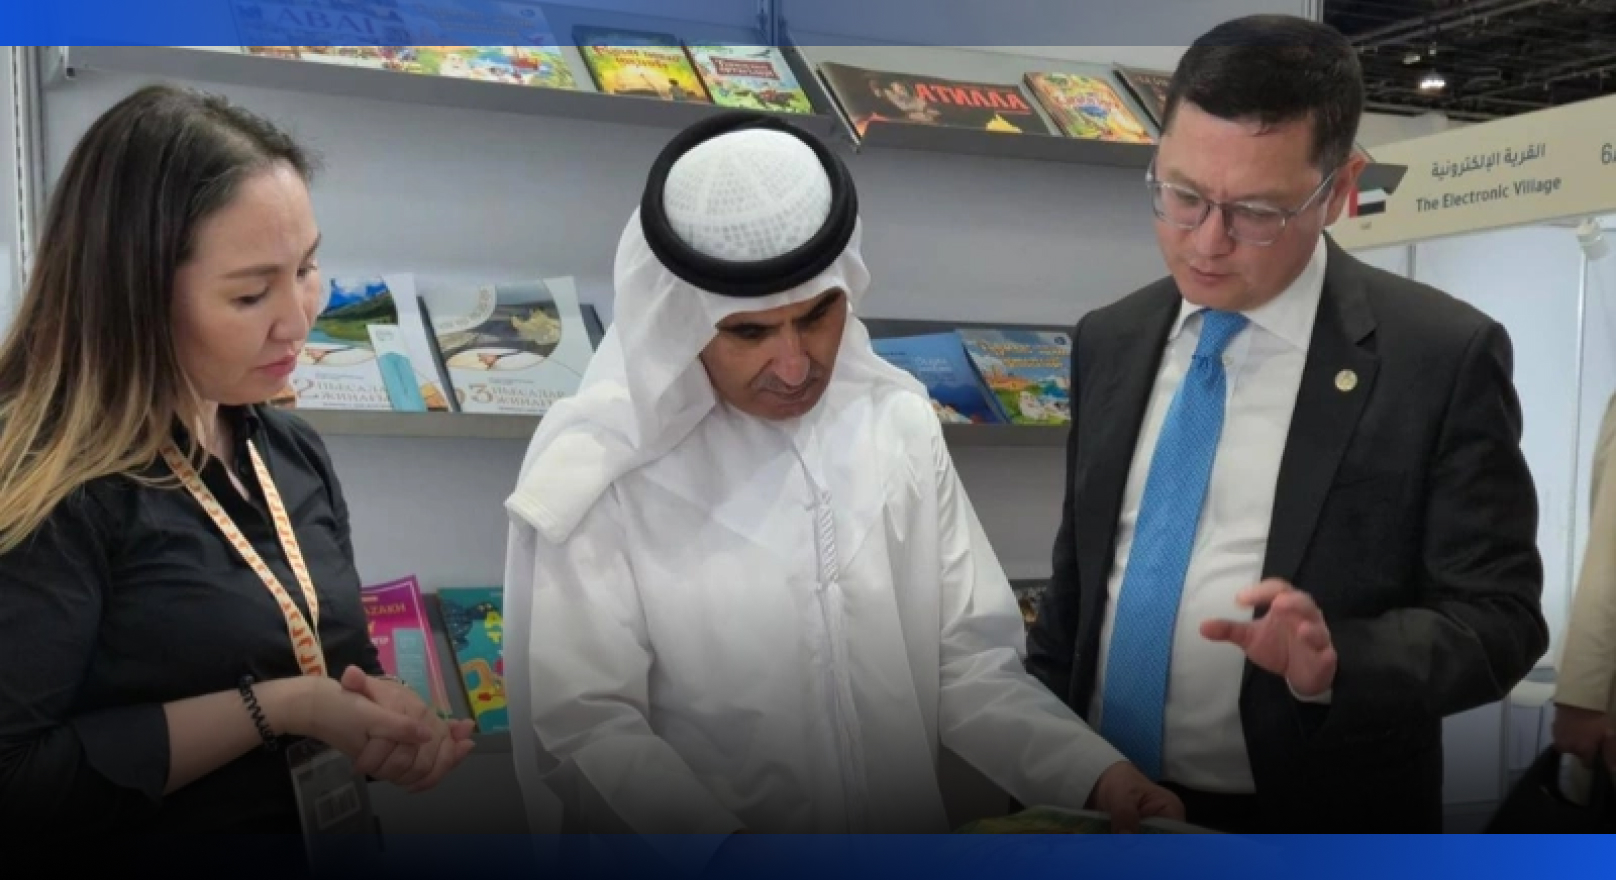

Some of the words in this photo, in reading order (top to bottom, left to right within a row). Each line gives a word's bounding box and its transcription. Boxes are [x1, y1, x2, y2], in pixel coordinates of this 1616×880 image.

[915, 84, 1030, 110] АТИЛЛА
[1431, 153, 1501, 179] الإلكترونية
[1504, 144, 1545, 167] القرية
[1416, 197, 1438, 213] The
[1442, 184, 1509, 208] Electronic
[1514, 176, 1562, 198] Village
[468, 383, 494, 403] 3
